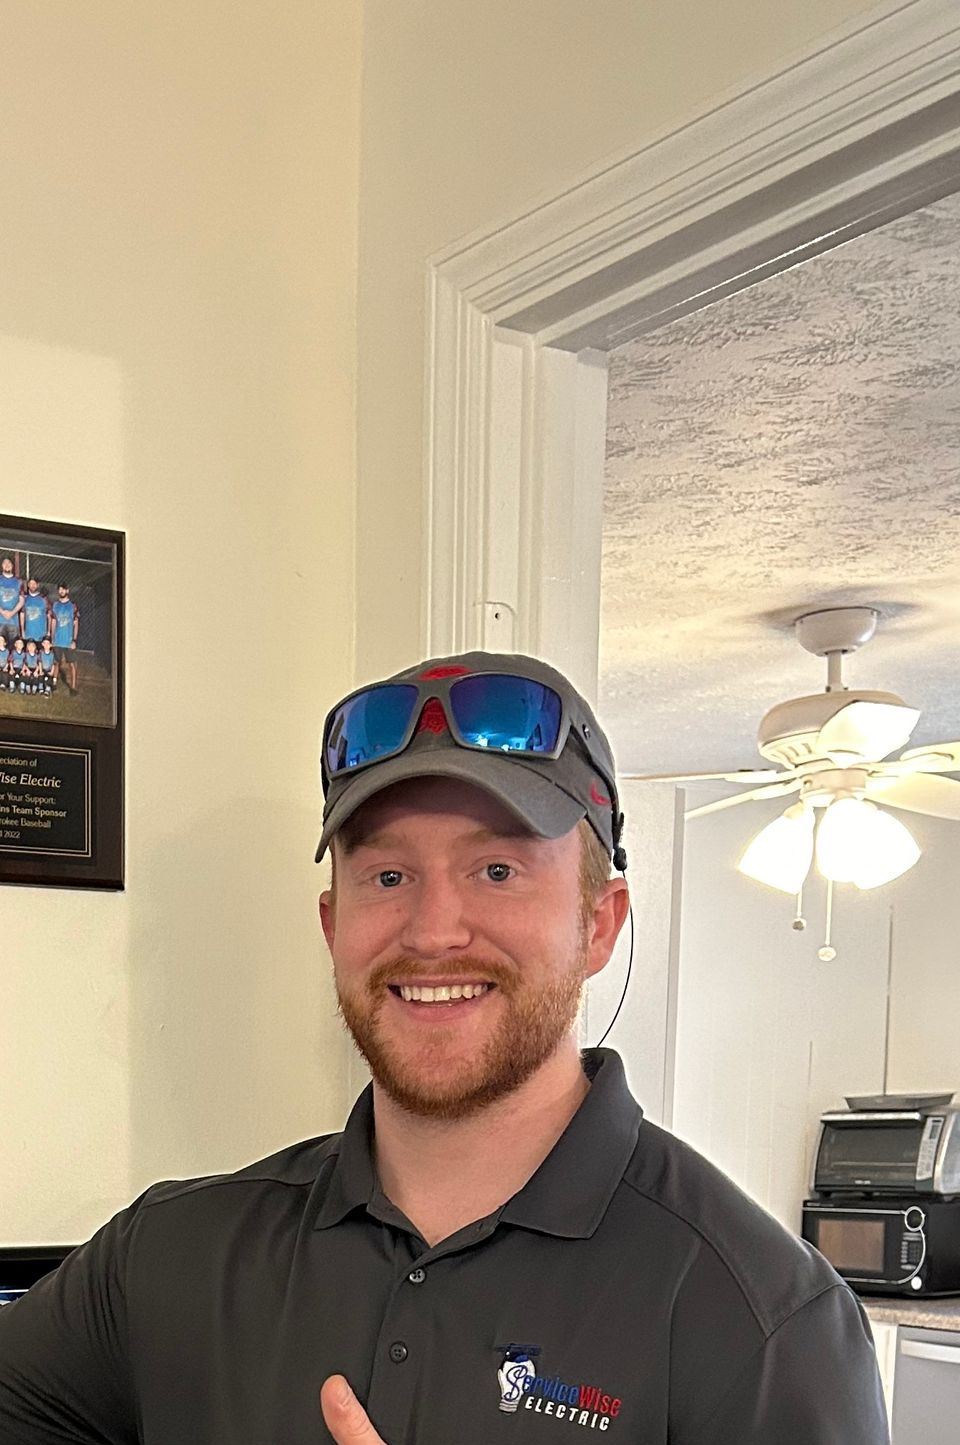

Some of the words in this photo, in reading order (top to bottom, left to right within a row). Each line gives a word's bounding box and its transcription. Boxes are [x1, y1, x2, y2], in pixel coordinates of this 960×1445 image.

[30, 758, 37, 767] of
[20, 774, 62, 788] Electric
[7, 792, 23, 801] Your
[25, 794, 56, 804] Support:
[12, 805, 32, 814] Team
[35, 807, 67, 818] Sponsor
[21, 818, 51, 828] Baseball
[4, 830, 20, 838] 2022
[504, 1365, 622, 1417] ServiceWise
[525, 1396, 610, 1430] ELECTRIC
